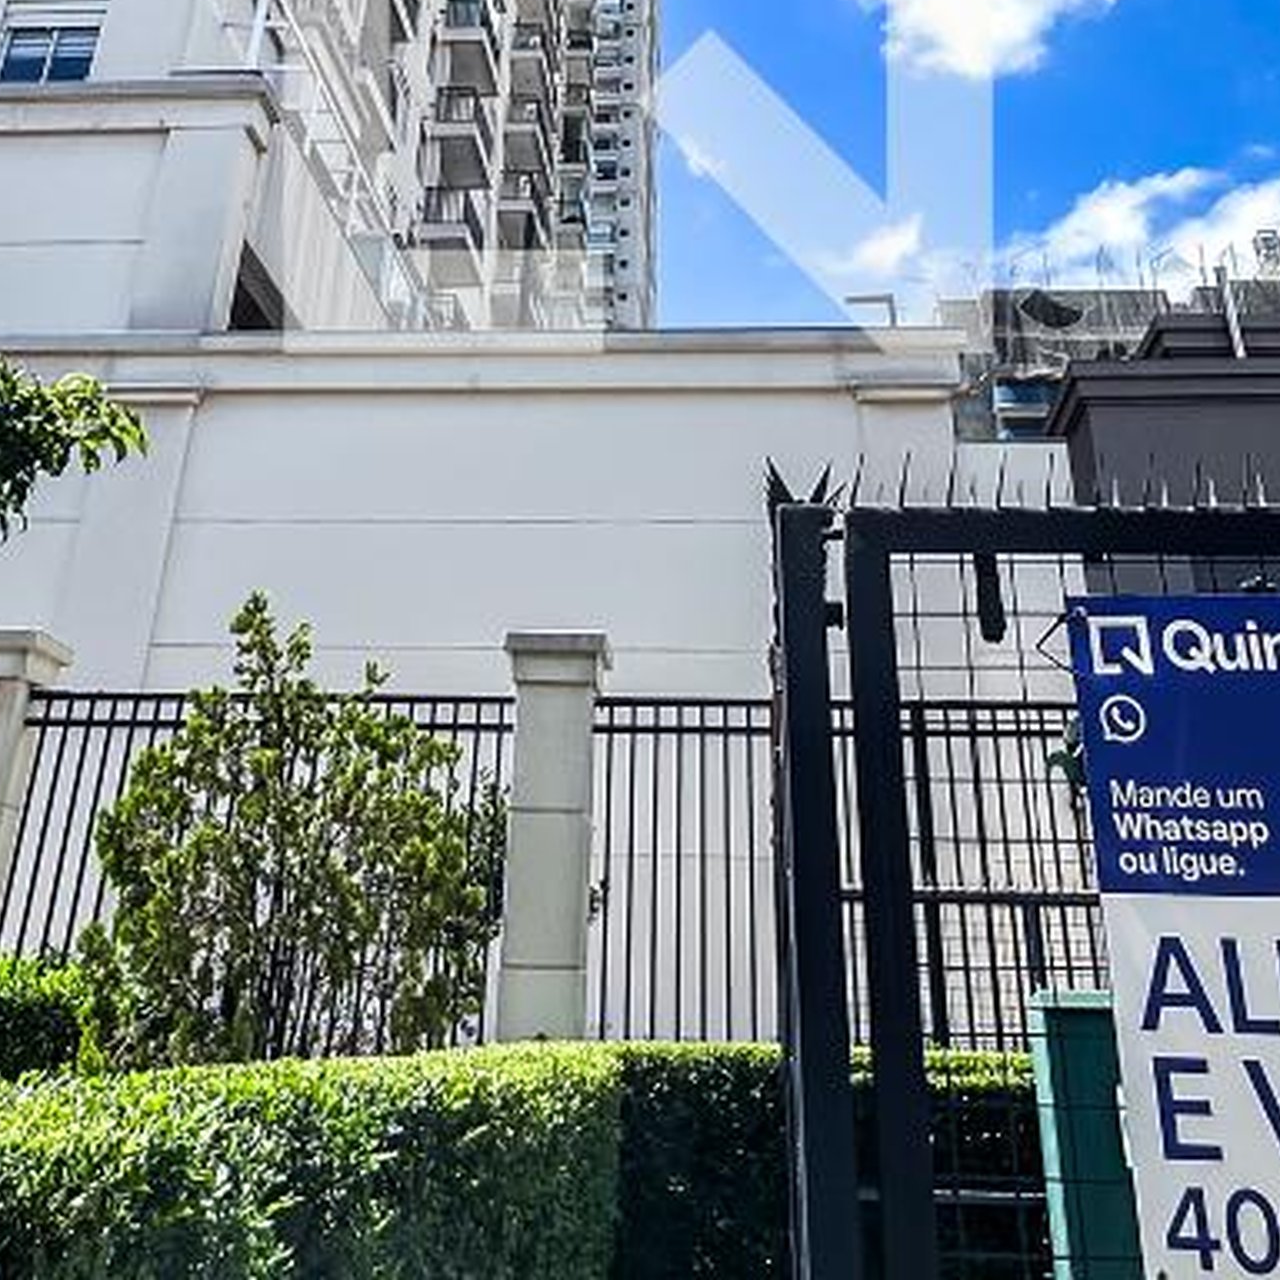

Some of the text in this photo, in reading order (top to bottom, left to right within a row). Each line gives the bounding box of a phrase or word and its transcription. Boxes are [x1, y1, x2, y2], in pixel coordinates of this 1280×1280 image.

[1109, 779, 1265, 810] Mande um
[1112, 812, 1270, 849] Whatsapp
[1118, 845, 1246, 881] ou ligue.
[1152, 1056, 1224, 1162] E
